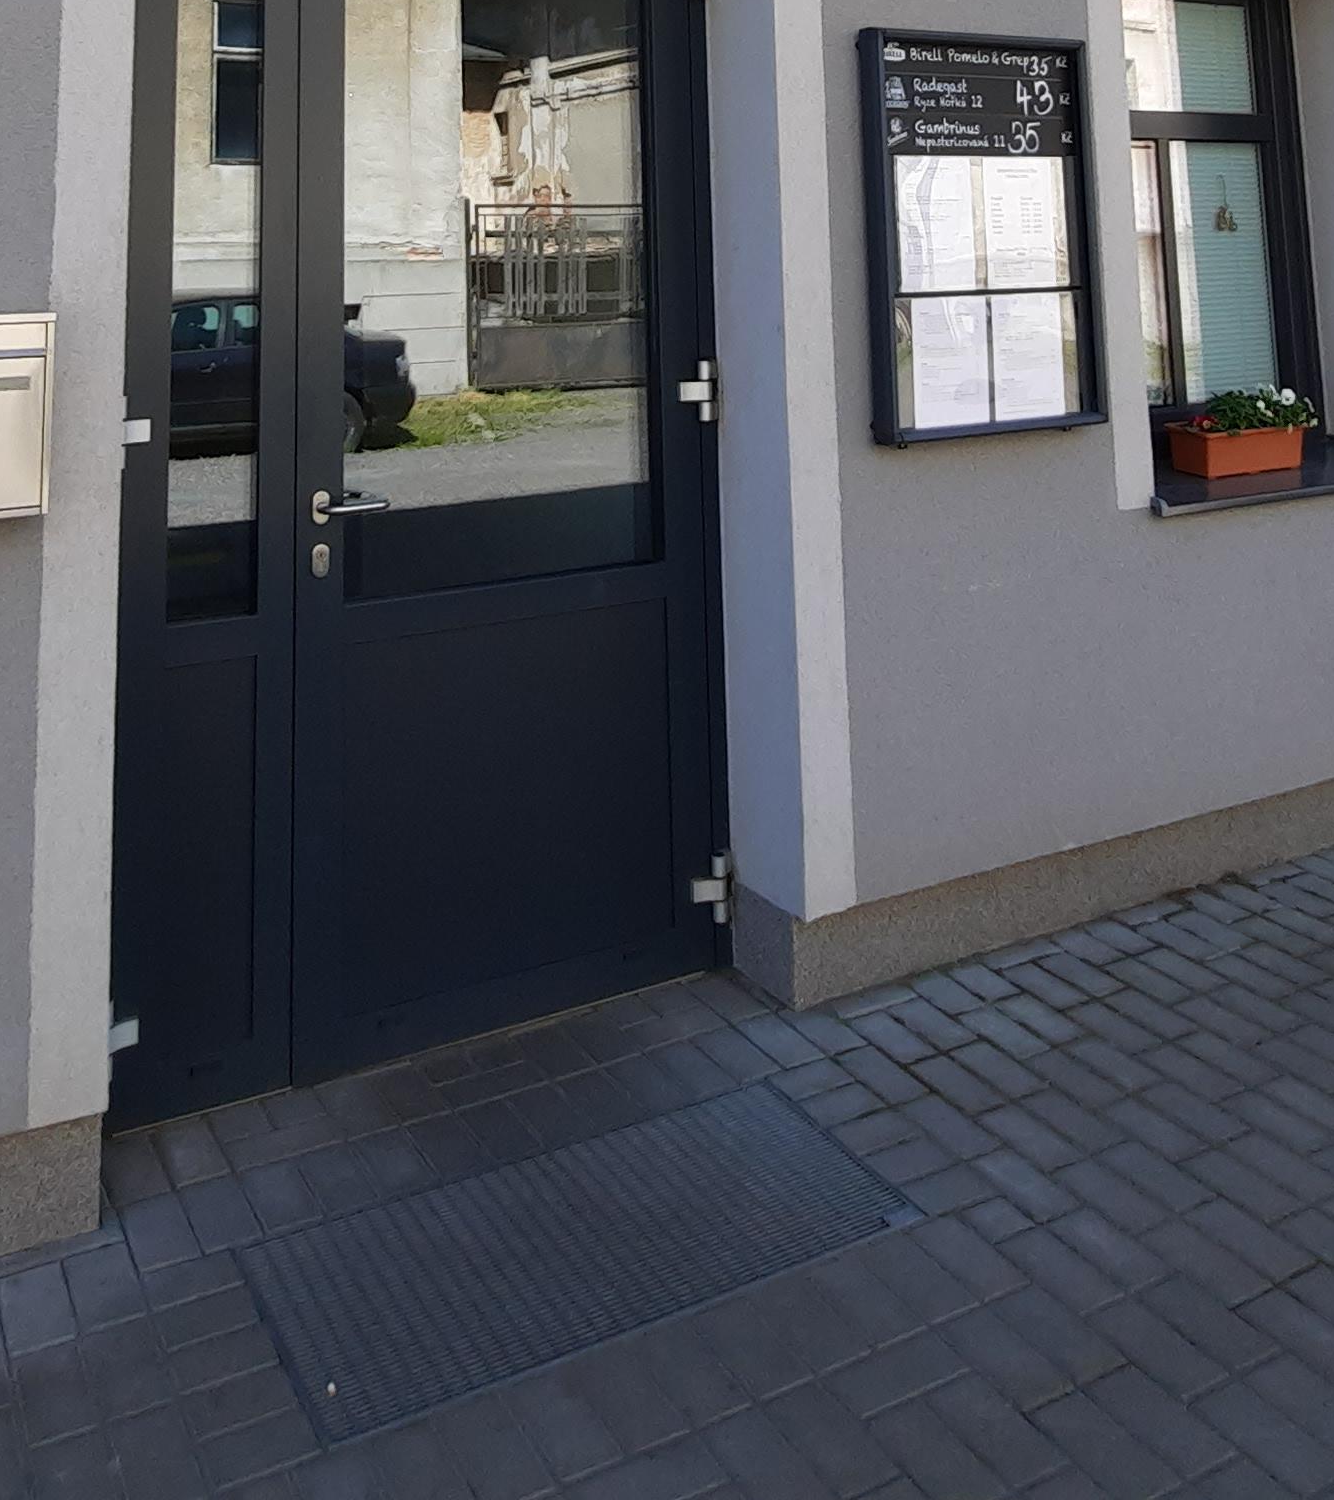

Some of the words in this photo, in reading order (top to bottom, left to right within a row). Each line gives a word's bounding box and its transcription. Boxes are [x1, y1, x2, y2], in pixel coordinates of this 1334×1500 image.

[909, 47, 943, 62] Birell
[947, 48, 990, 64] Pomelo
[1000, 51, 1028, 74] Grep
[1029, 55, 1053, 76] 35
[913, 76, 968, 98] Radegast
[1016, 79, 1054, 116] 43
[970, 94, 983, 108] 12
[914, 116, 981, 136] Gambrinus
[1008, 120, 1042, 154] 35
[993, 134, 1006, 148] 11
